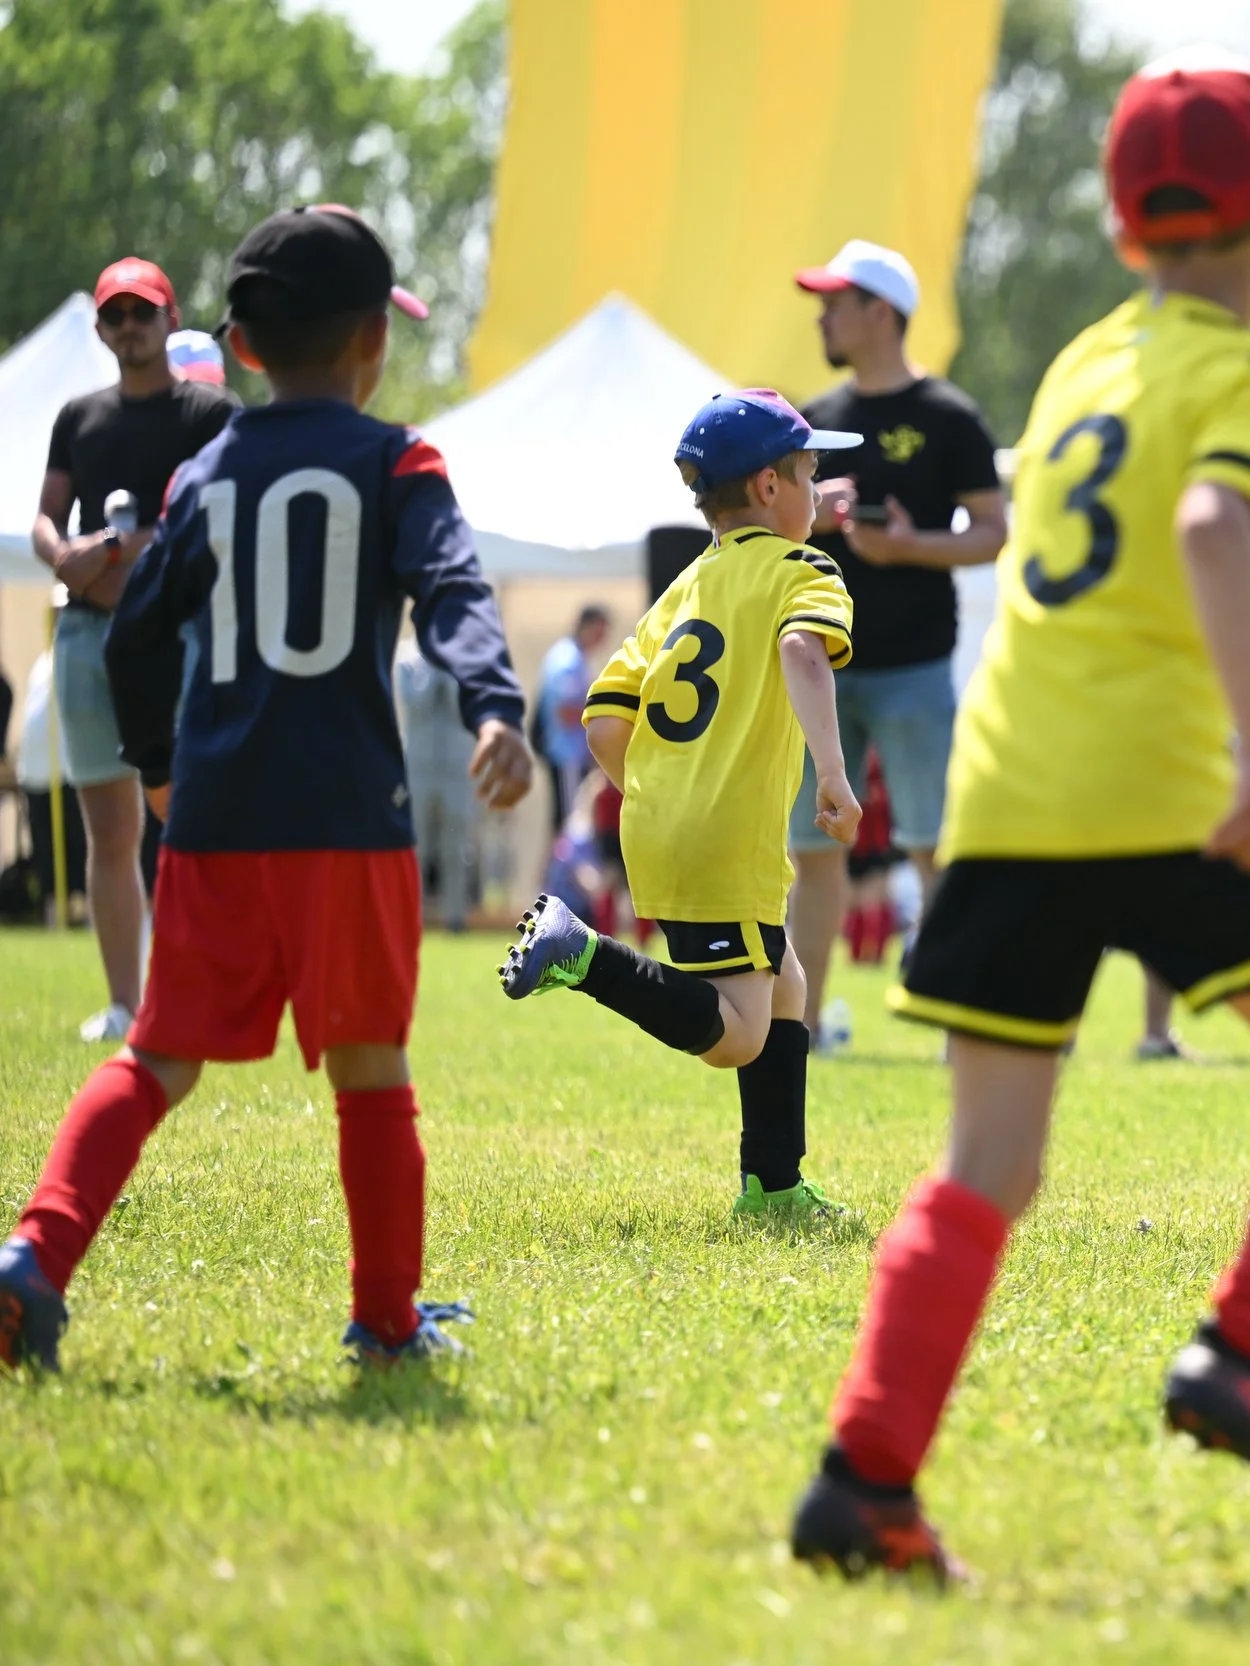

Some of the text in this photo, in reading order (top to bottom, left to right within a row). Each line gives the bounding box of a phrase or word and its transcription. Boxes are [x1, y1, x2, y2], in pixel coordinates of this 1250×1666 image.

[199, 467, 362, 684] 10
[1023, 413, 1128, 607] 3
[646, 618, 725, 743] 3
